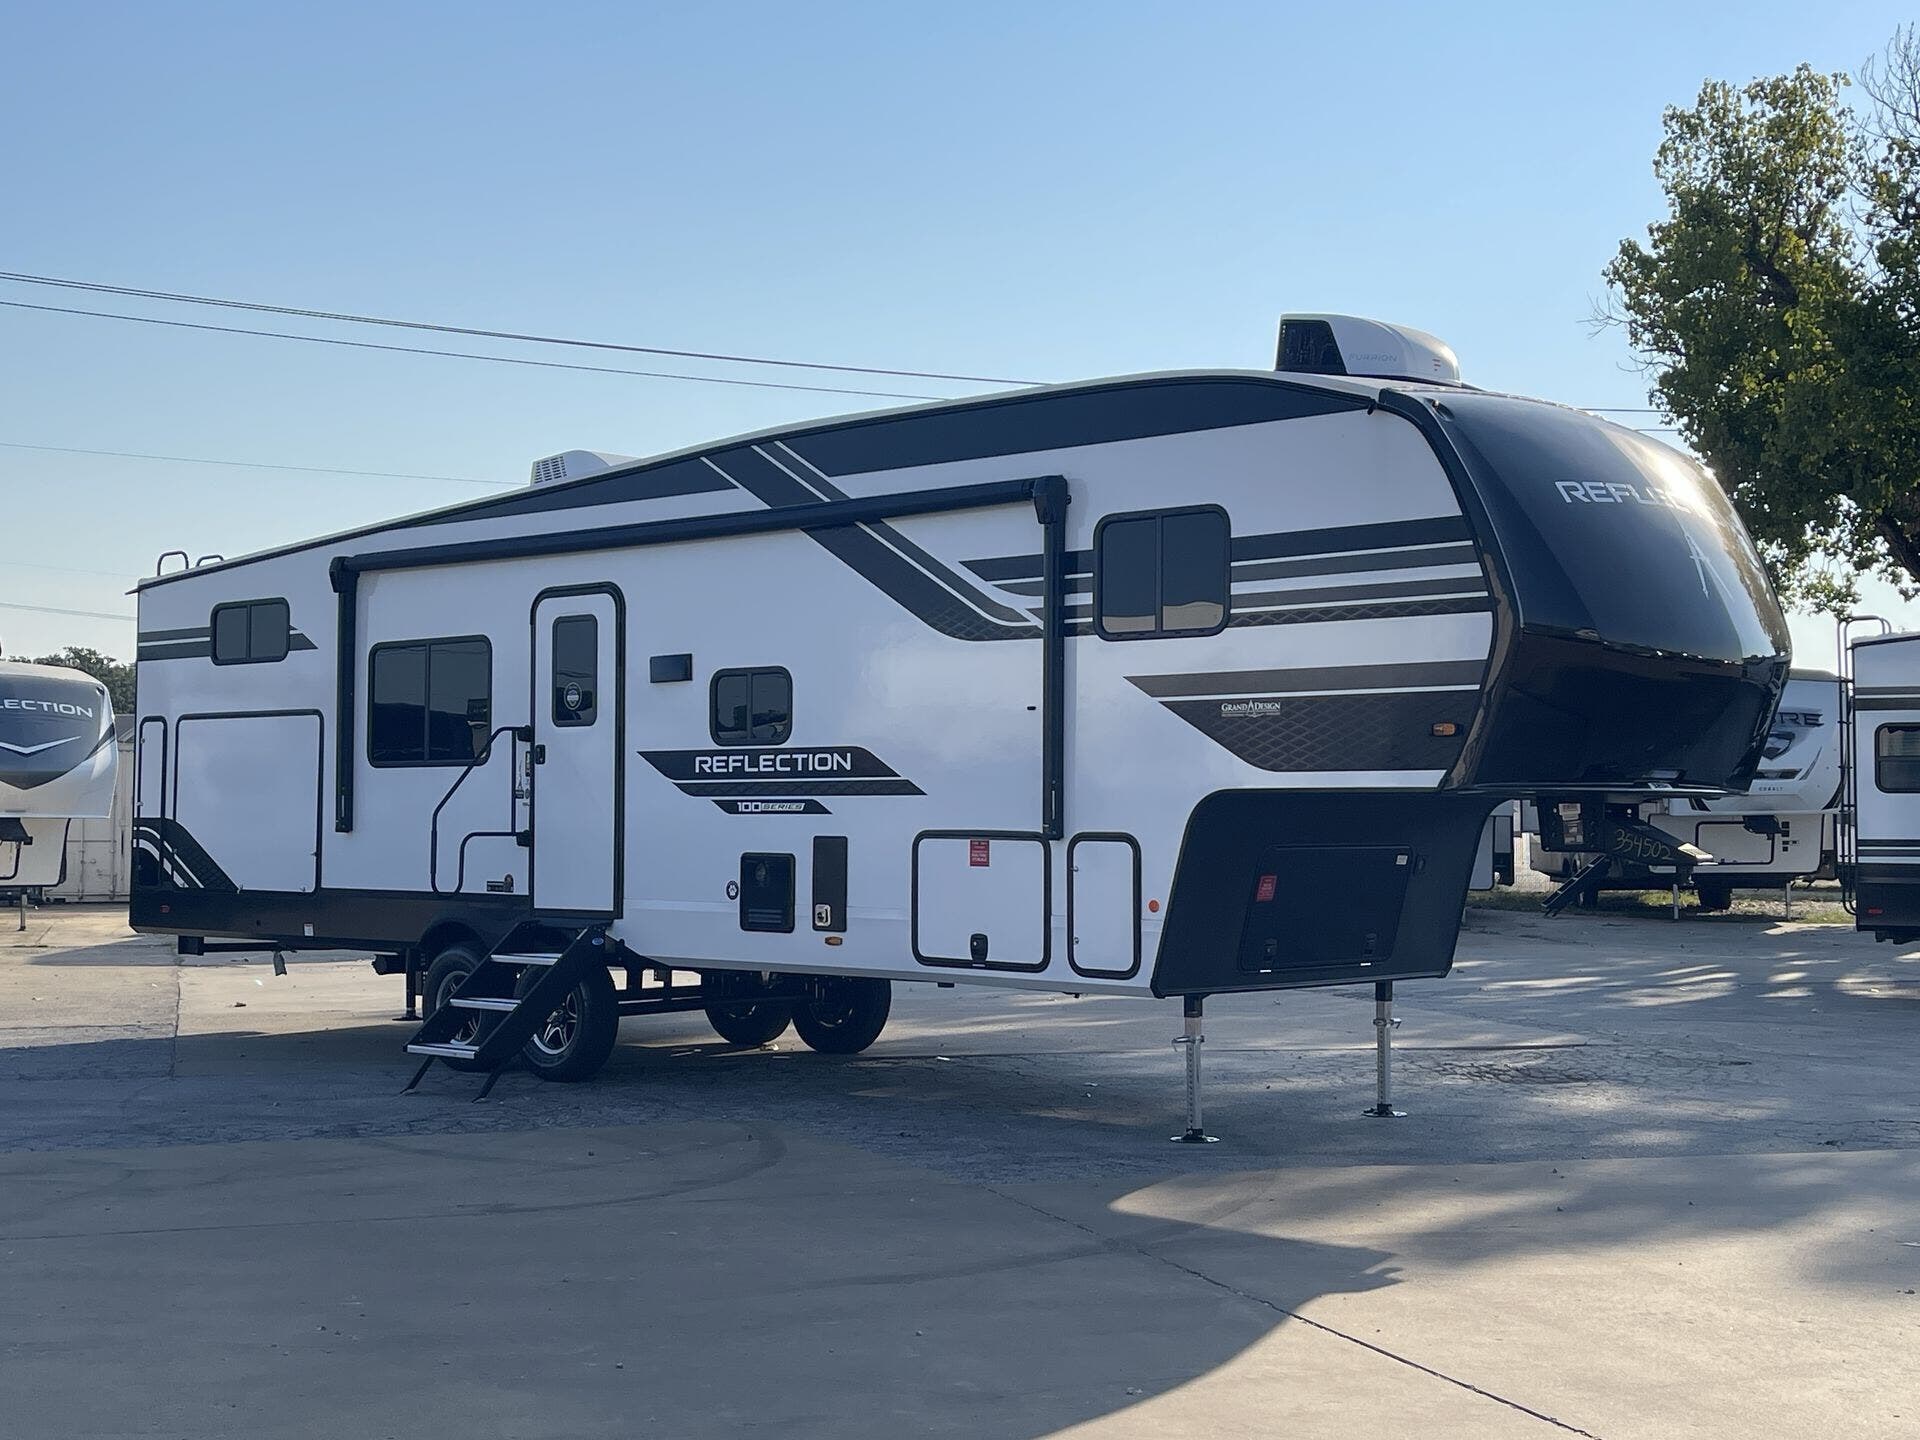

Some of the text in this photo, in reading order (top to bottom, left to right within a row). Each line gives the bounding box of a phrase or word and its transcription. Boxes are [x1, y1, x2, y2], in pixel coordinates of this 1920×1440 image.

[1221, 702, 1280, 711] GRAND DESIGN
[1774, 712, 1824, 727] RE
[695, 753, 851, 773] REFLECTION
[1613, 829, 1673, 860] 354502
